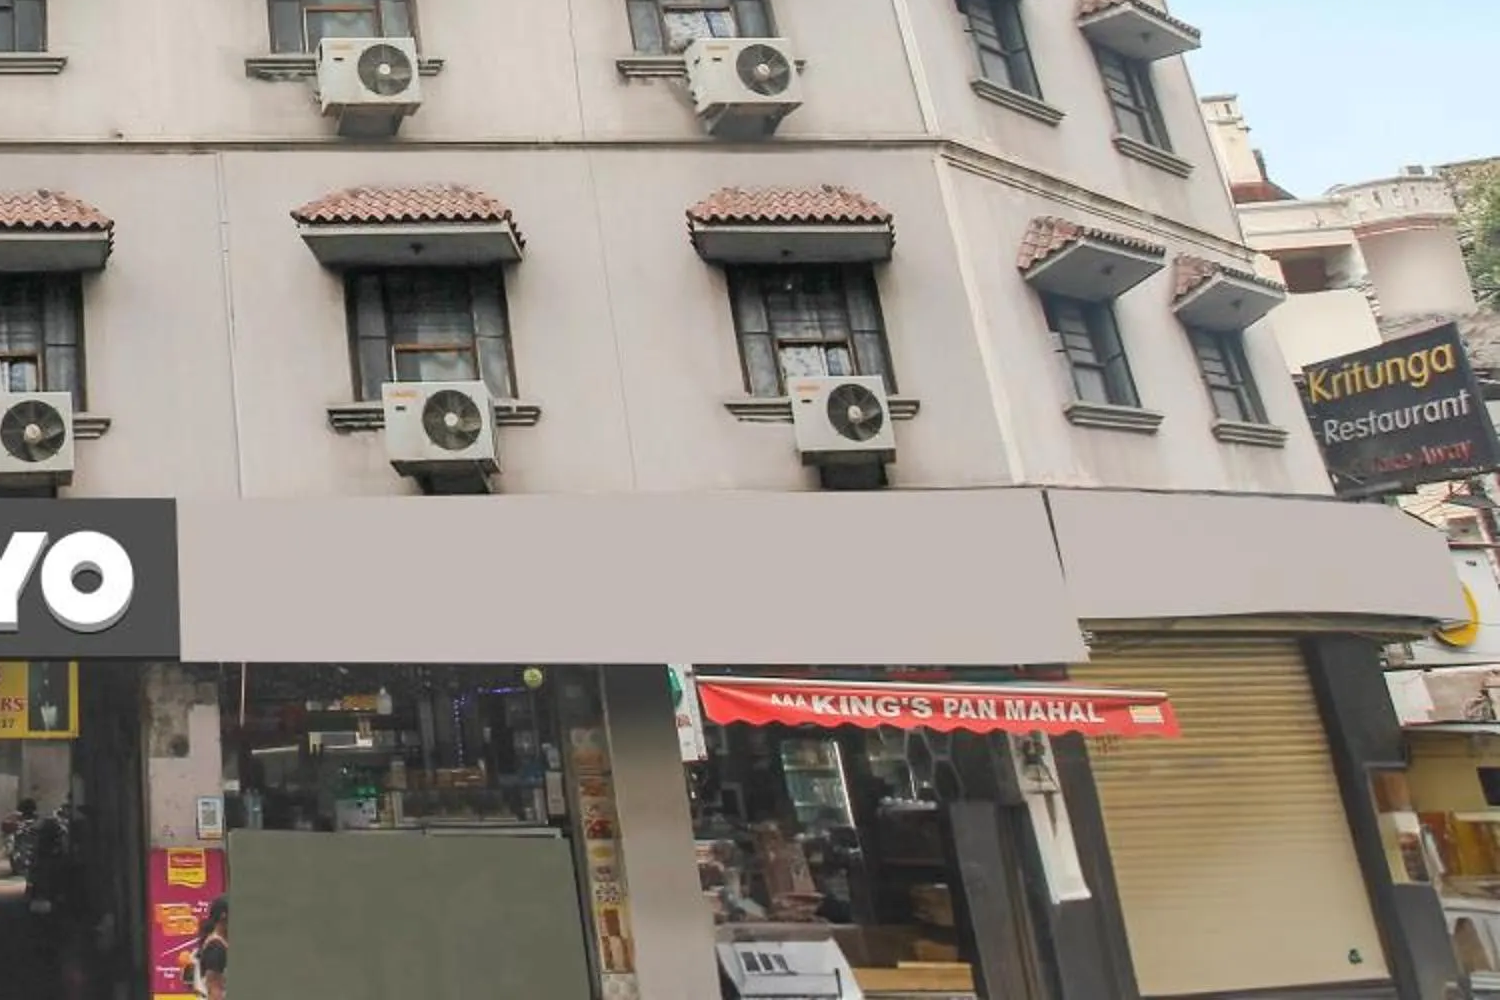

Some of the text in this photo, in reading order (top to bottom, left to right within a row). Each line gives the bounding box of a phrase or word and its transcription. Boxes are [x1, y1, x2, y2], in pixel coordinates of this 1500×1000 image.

[1308, 343, 1457, 405] Kritunga
[1322, 389, 1472, 446] Restaurant
[811, 695, 933, 718] KING'S
[943, 697, 998, 721] PAN
[1004, 700, 1105, 724] MAHAL
